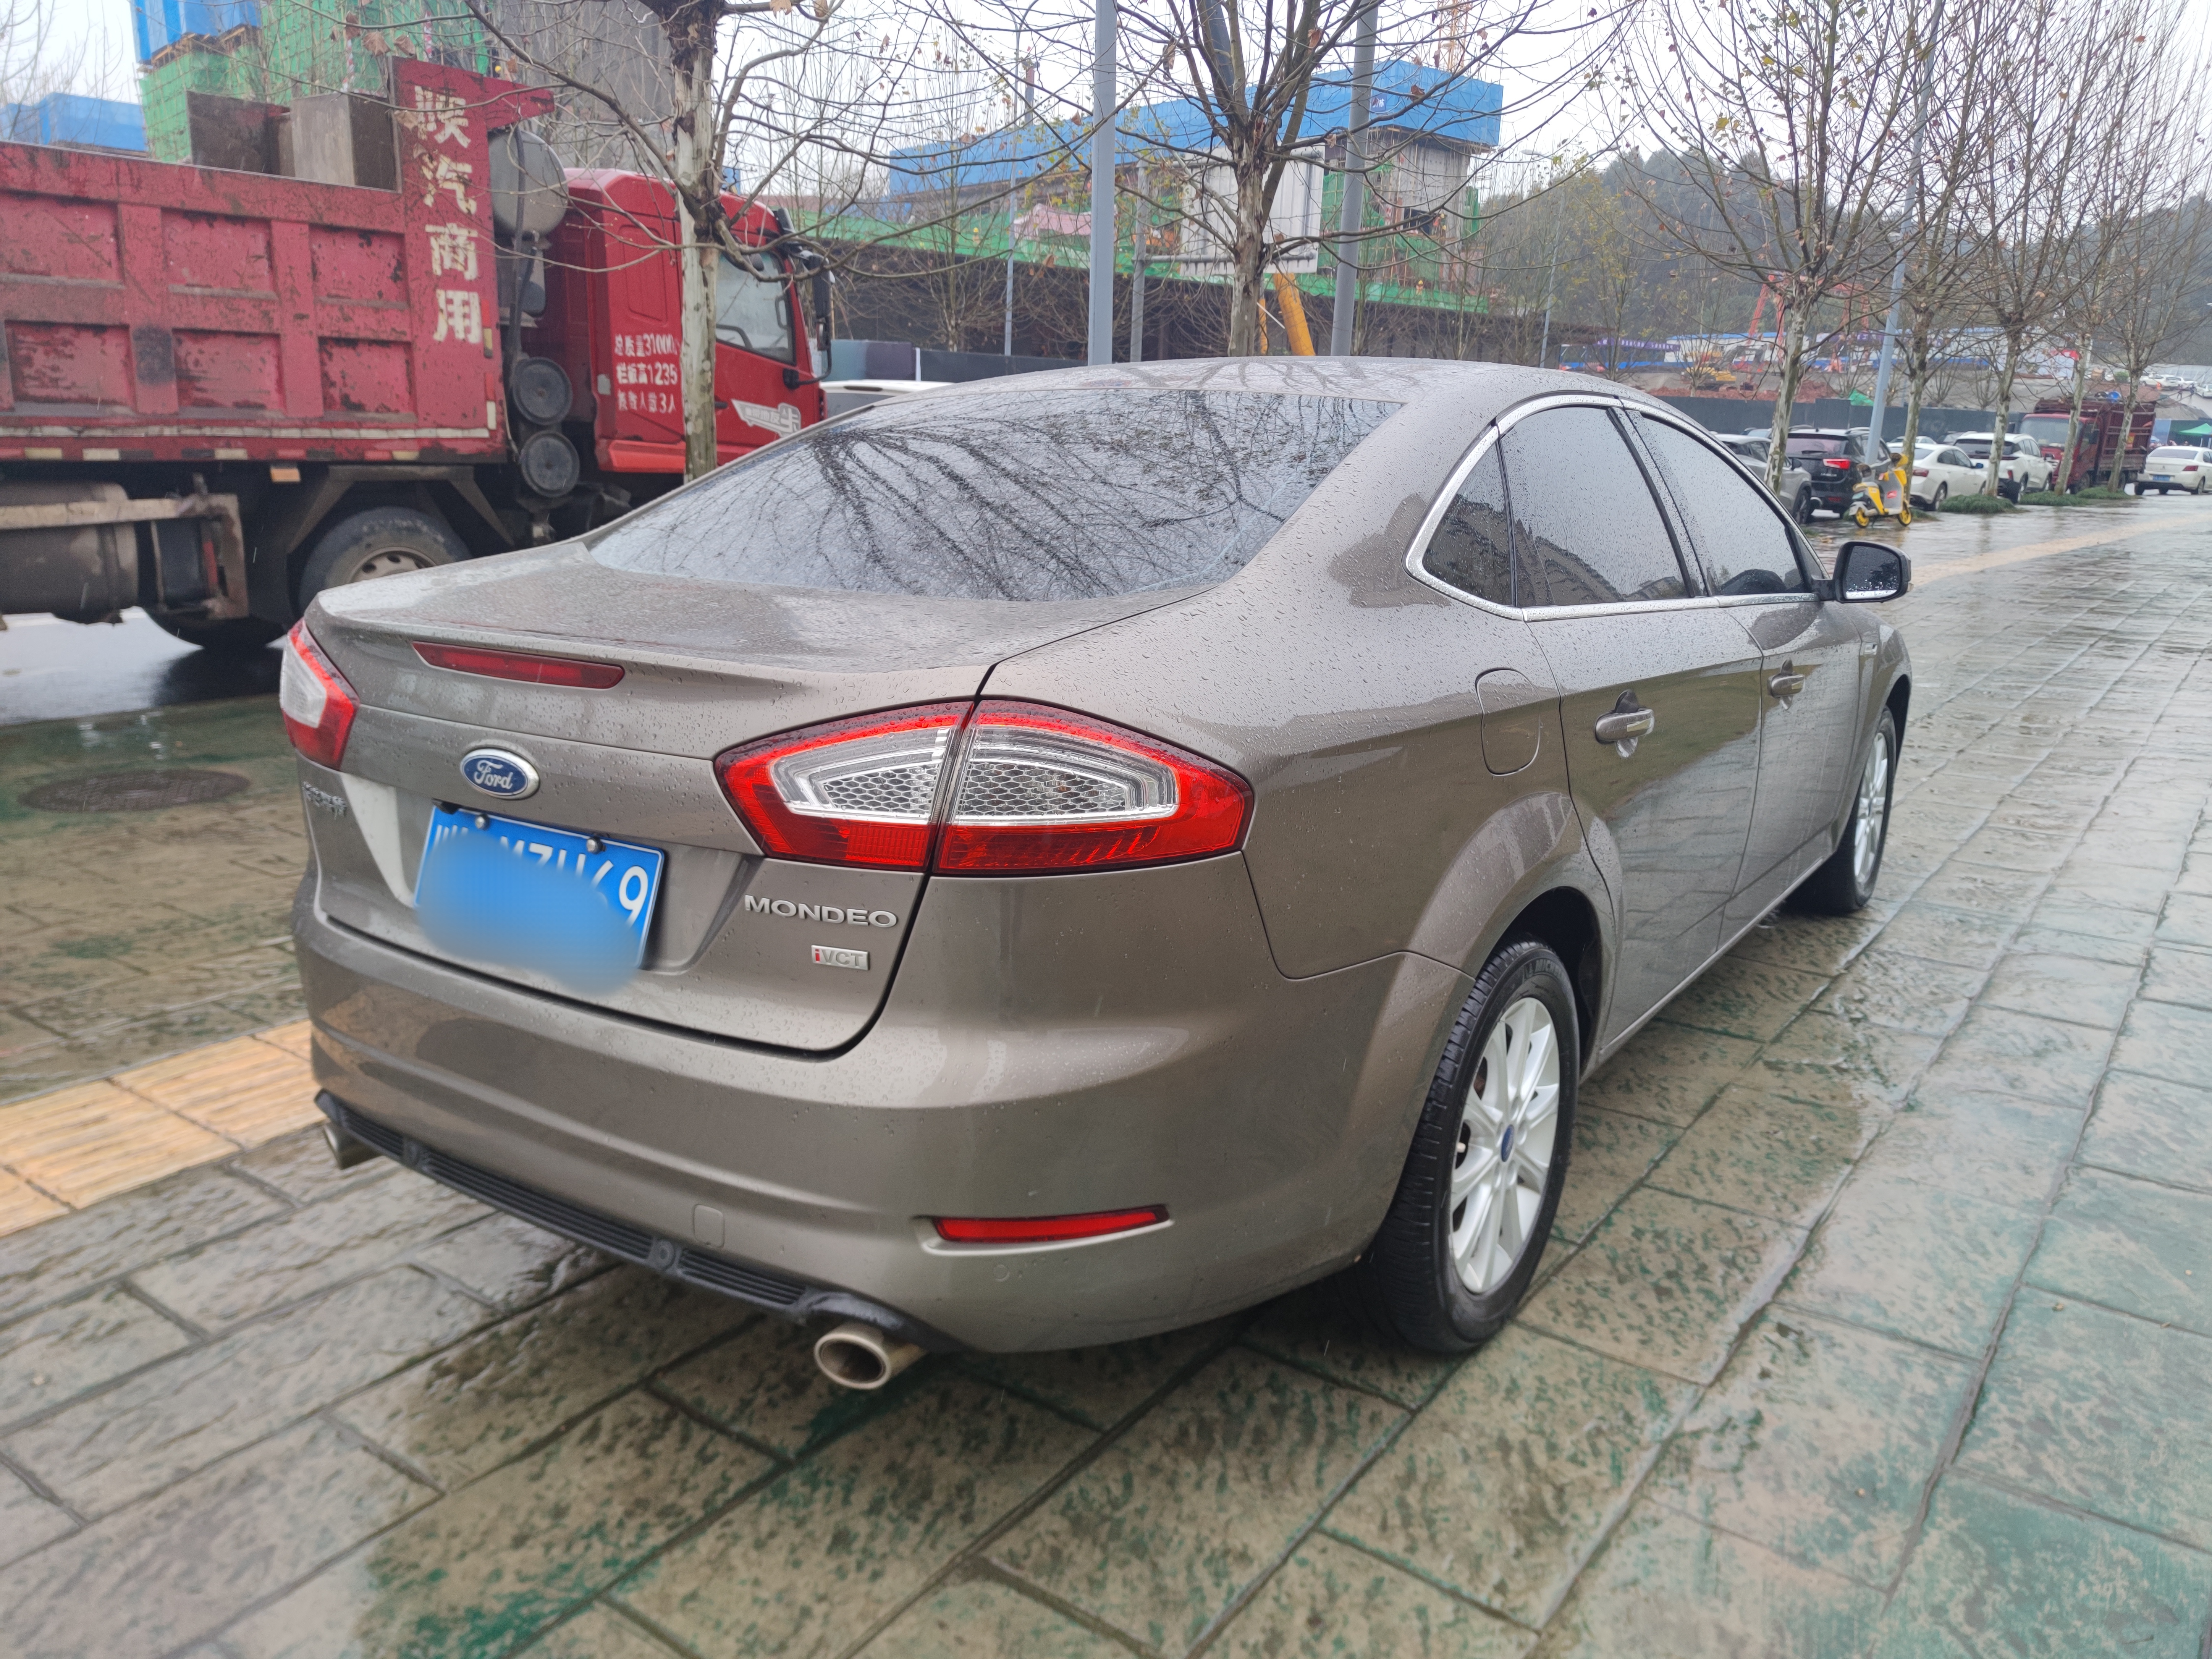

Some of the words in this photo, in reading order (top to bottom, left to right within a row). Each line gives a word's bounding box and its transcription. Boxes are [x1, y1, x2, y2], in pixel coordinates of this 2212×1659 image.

[415, 85, 481, 344] 陕汽商用
[614, 333, 680, 357] 总质量31000
[474, 759, 514, 790] Ford
[745, 894, 898, 928] MONDEO
